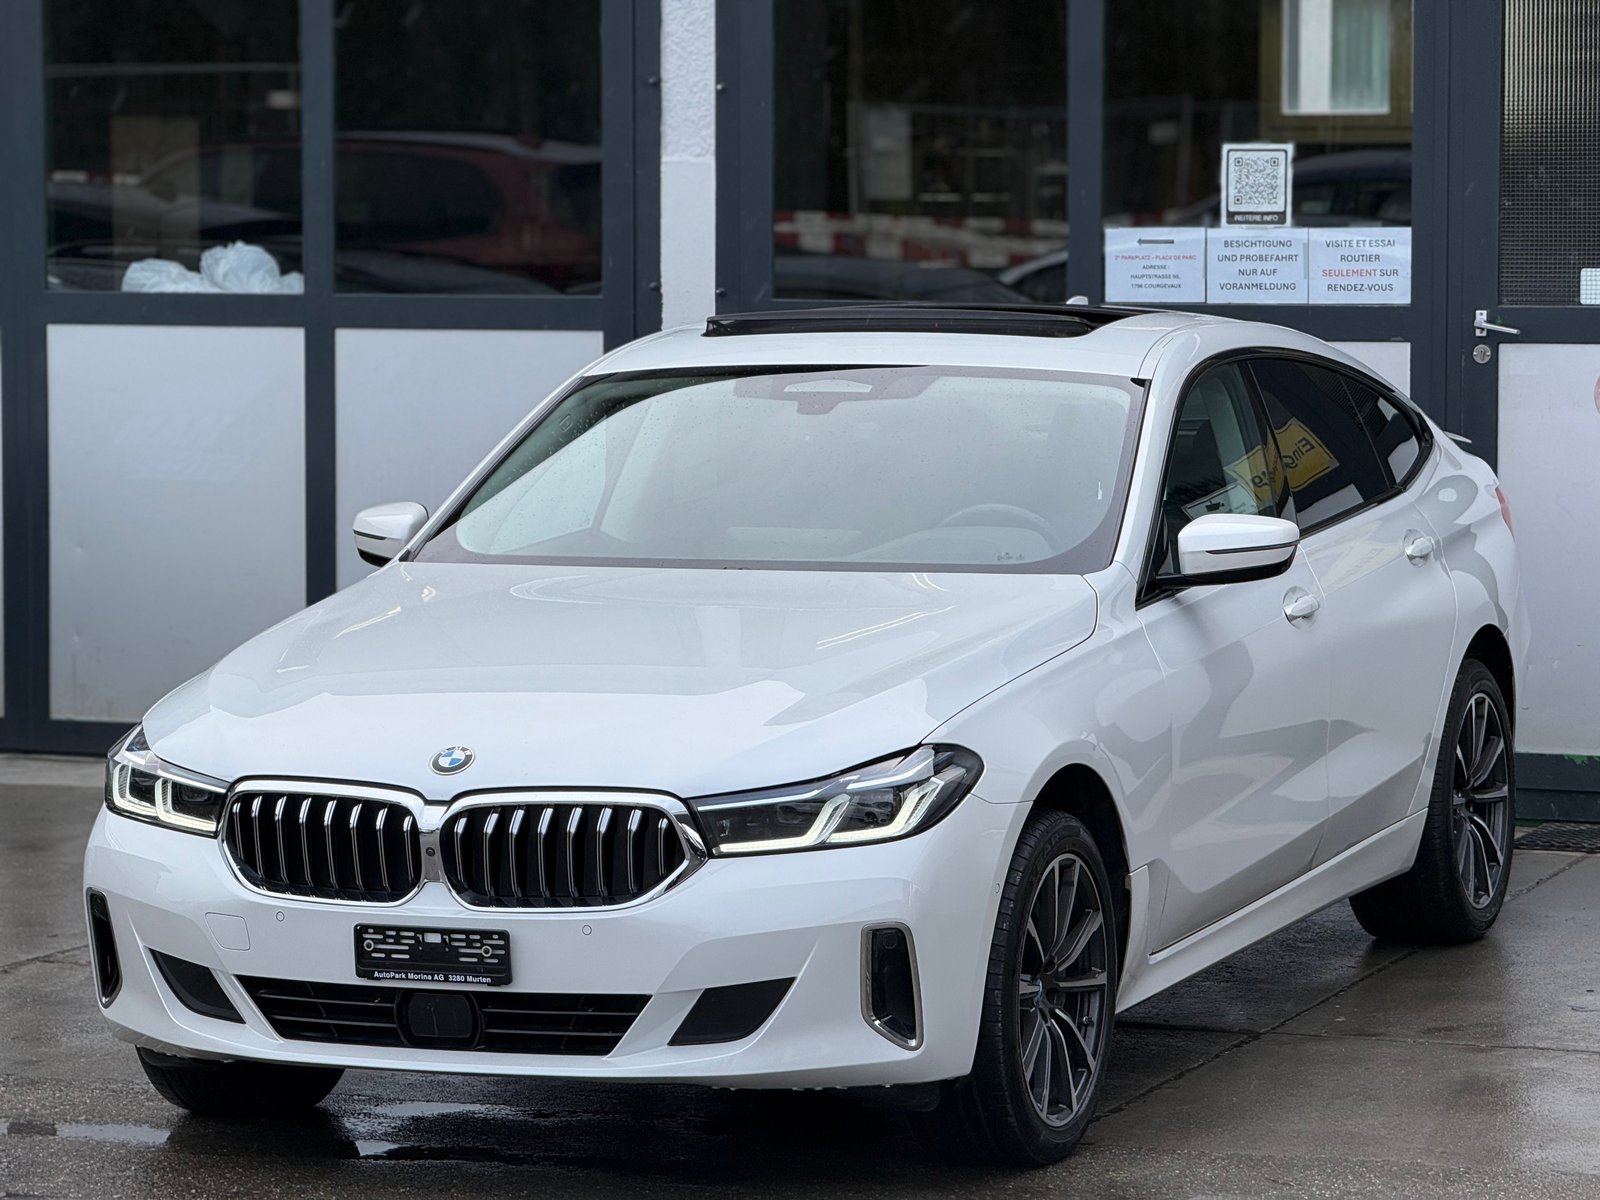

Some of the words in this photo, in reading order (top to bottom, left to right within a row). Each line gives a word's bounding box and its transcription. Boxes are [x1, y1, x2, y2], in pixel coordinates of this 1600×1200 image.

[1263, 214, 1278, 222] INFO
[1224, 240, 1292, 248] BESICHTIGUNG
[1325, 240, 1354, 248] VISITE
[1356, 240, 1367, 248] ET
[1368, 240, 1395, 248] ESSAI
[1218, 254, 1238, 262] UND
[1240, 254, 1298, 262] PROBEFAHRT
[1340, 254, 1380, 262] ROUTIER
[1238, 268, 1258, 276] NUR
[1260, 268, 1278, 276] AUF
[1322, 268, 1378, 277] SEULEMENT
[1380, 268, 1398, 276] SUR
[1218, 282, 1296, 291] VORANMELDUNG
[1327, 284, 1394, 292] RENDEZ-VOUS
[374, 971, 406, 979] AutoPark
[408, 972, 432, 980] Morina
